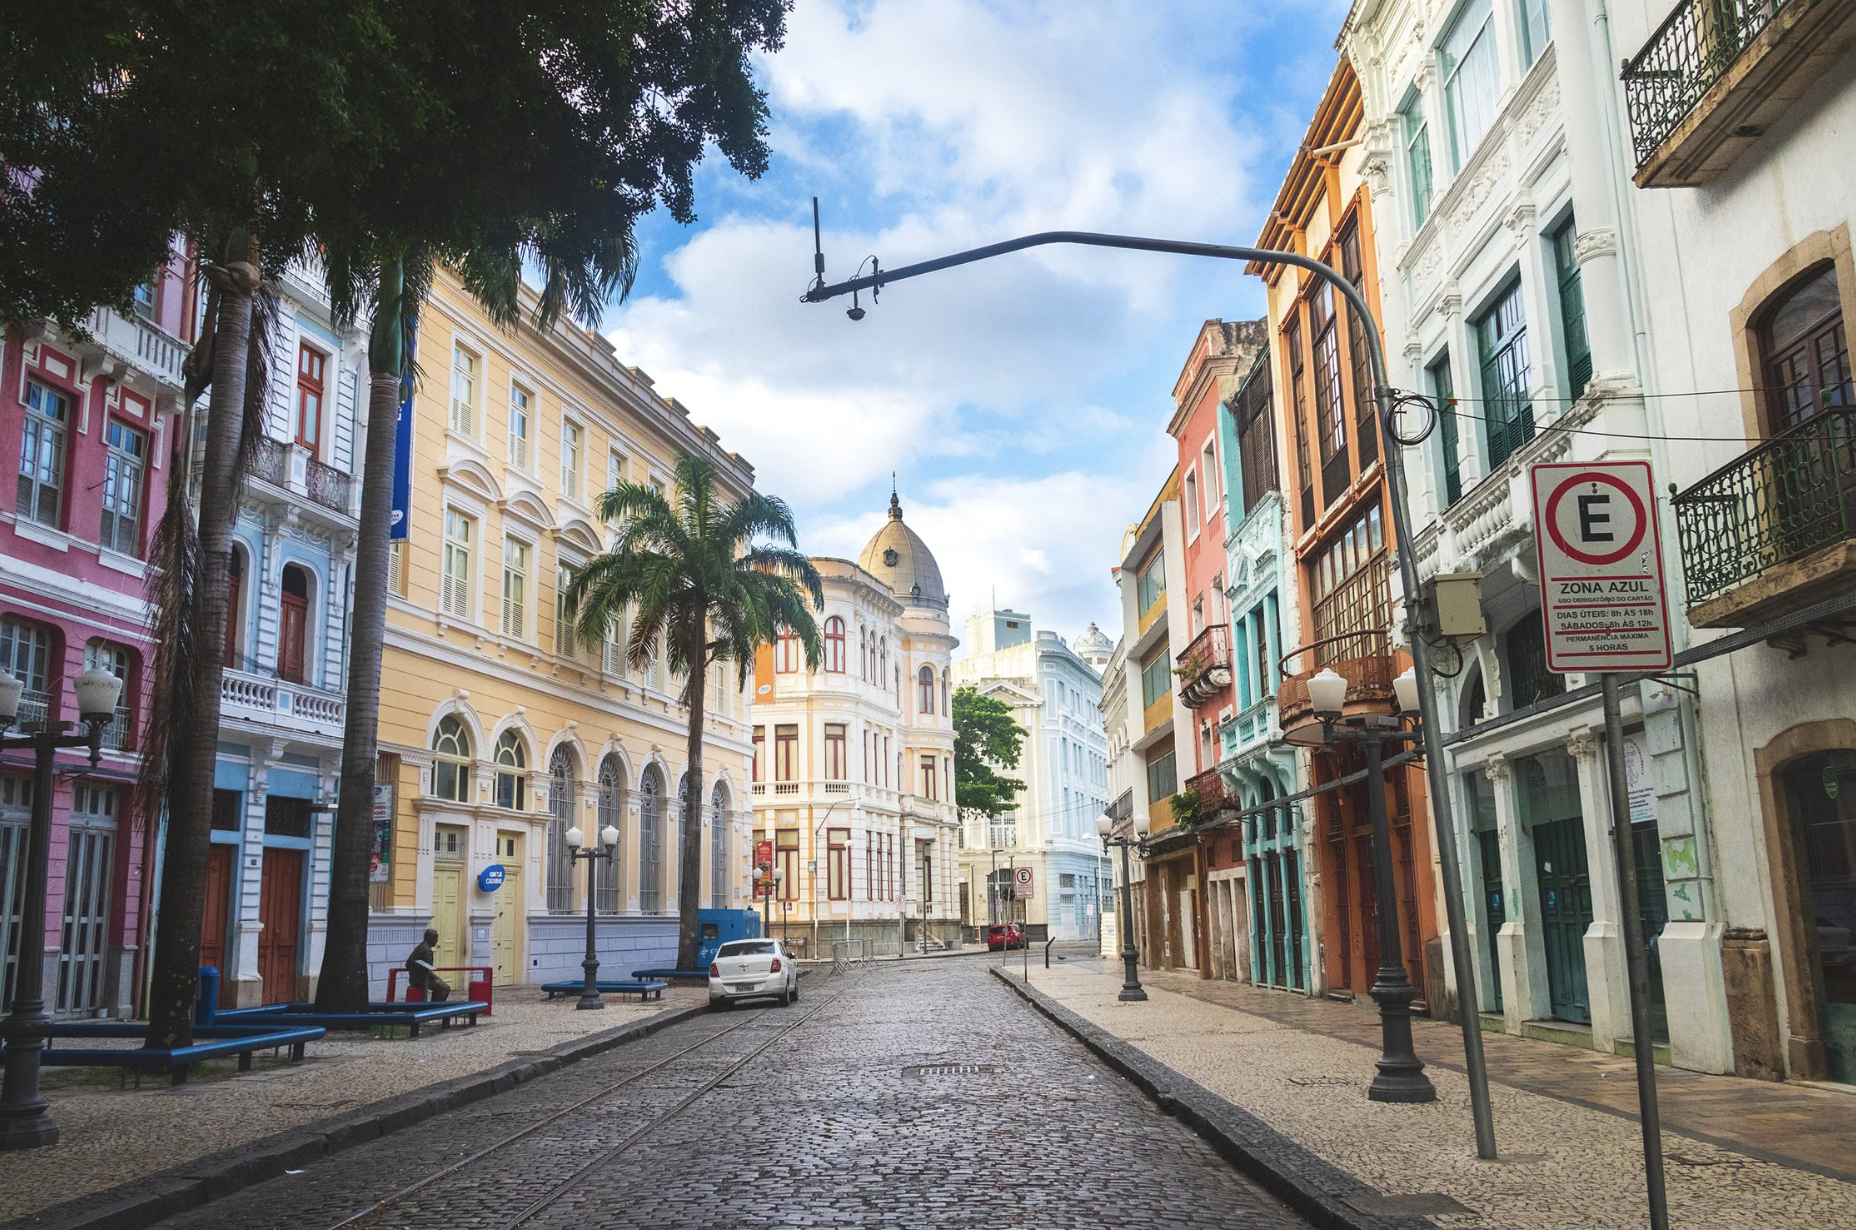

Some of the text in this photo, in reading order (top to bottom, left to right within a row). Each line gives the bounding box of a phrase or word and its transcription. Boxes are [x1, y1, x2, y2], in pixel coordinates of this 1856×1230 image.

[1577, 494, 1614, 542] E
[1560, 581, 1649, 594] ZONA AZUL
[1557, 611, 1578, 619] DIAS
[1580, 609, 1609, 618] ÚTEIS:
[1623, 608, 1636, 617] ÀS
[1561, 621, 1608, 630] SÁBADOS:
[1622, 619, 1634, 628] ÀS
[1637, 619, 1652, 627] 12h
[1566, 632, 1650, 642] PERMANÊNCIA MÁXIMA
[1596, 643, 1629, 651] HORAS
[1020, 872, 1026, 880] E
